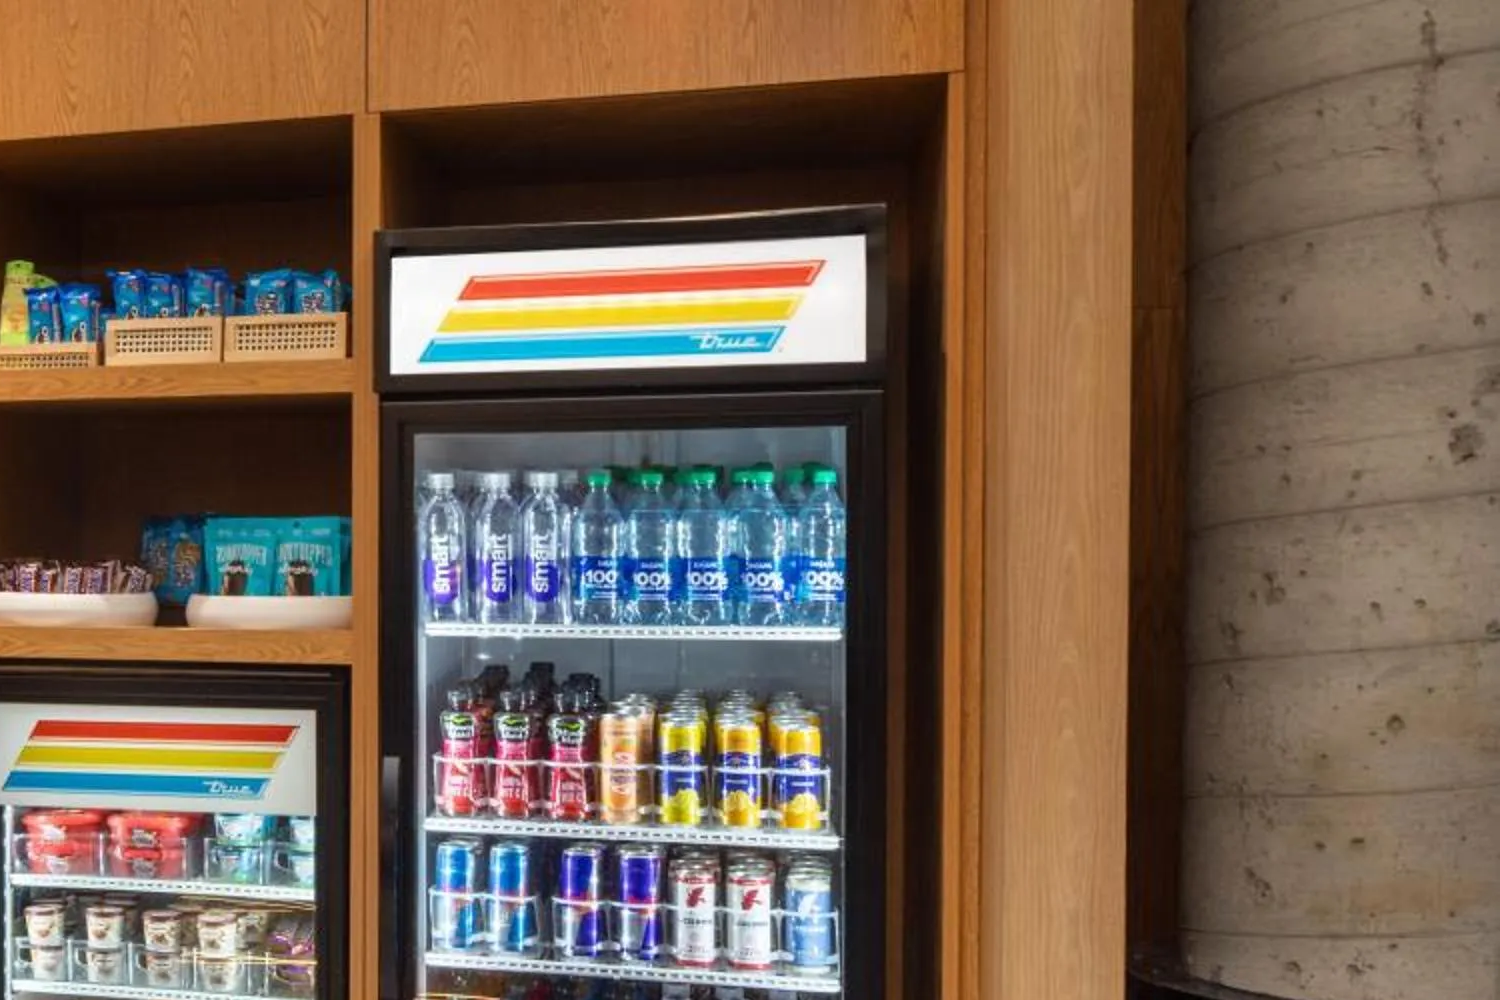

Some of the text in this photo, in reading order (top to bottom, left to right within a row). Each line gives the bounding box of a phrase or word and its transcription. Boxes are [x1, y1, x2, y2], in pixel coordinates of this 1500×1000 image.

[431, 533, 451, 594] smart
[489, 533, 509, 593] smart
[531, 533, 551, 593] smart
